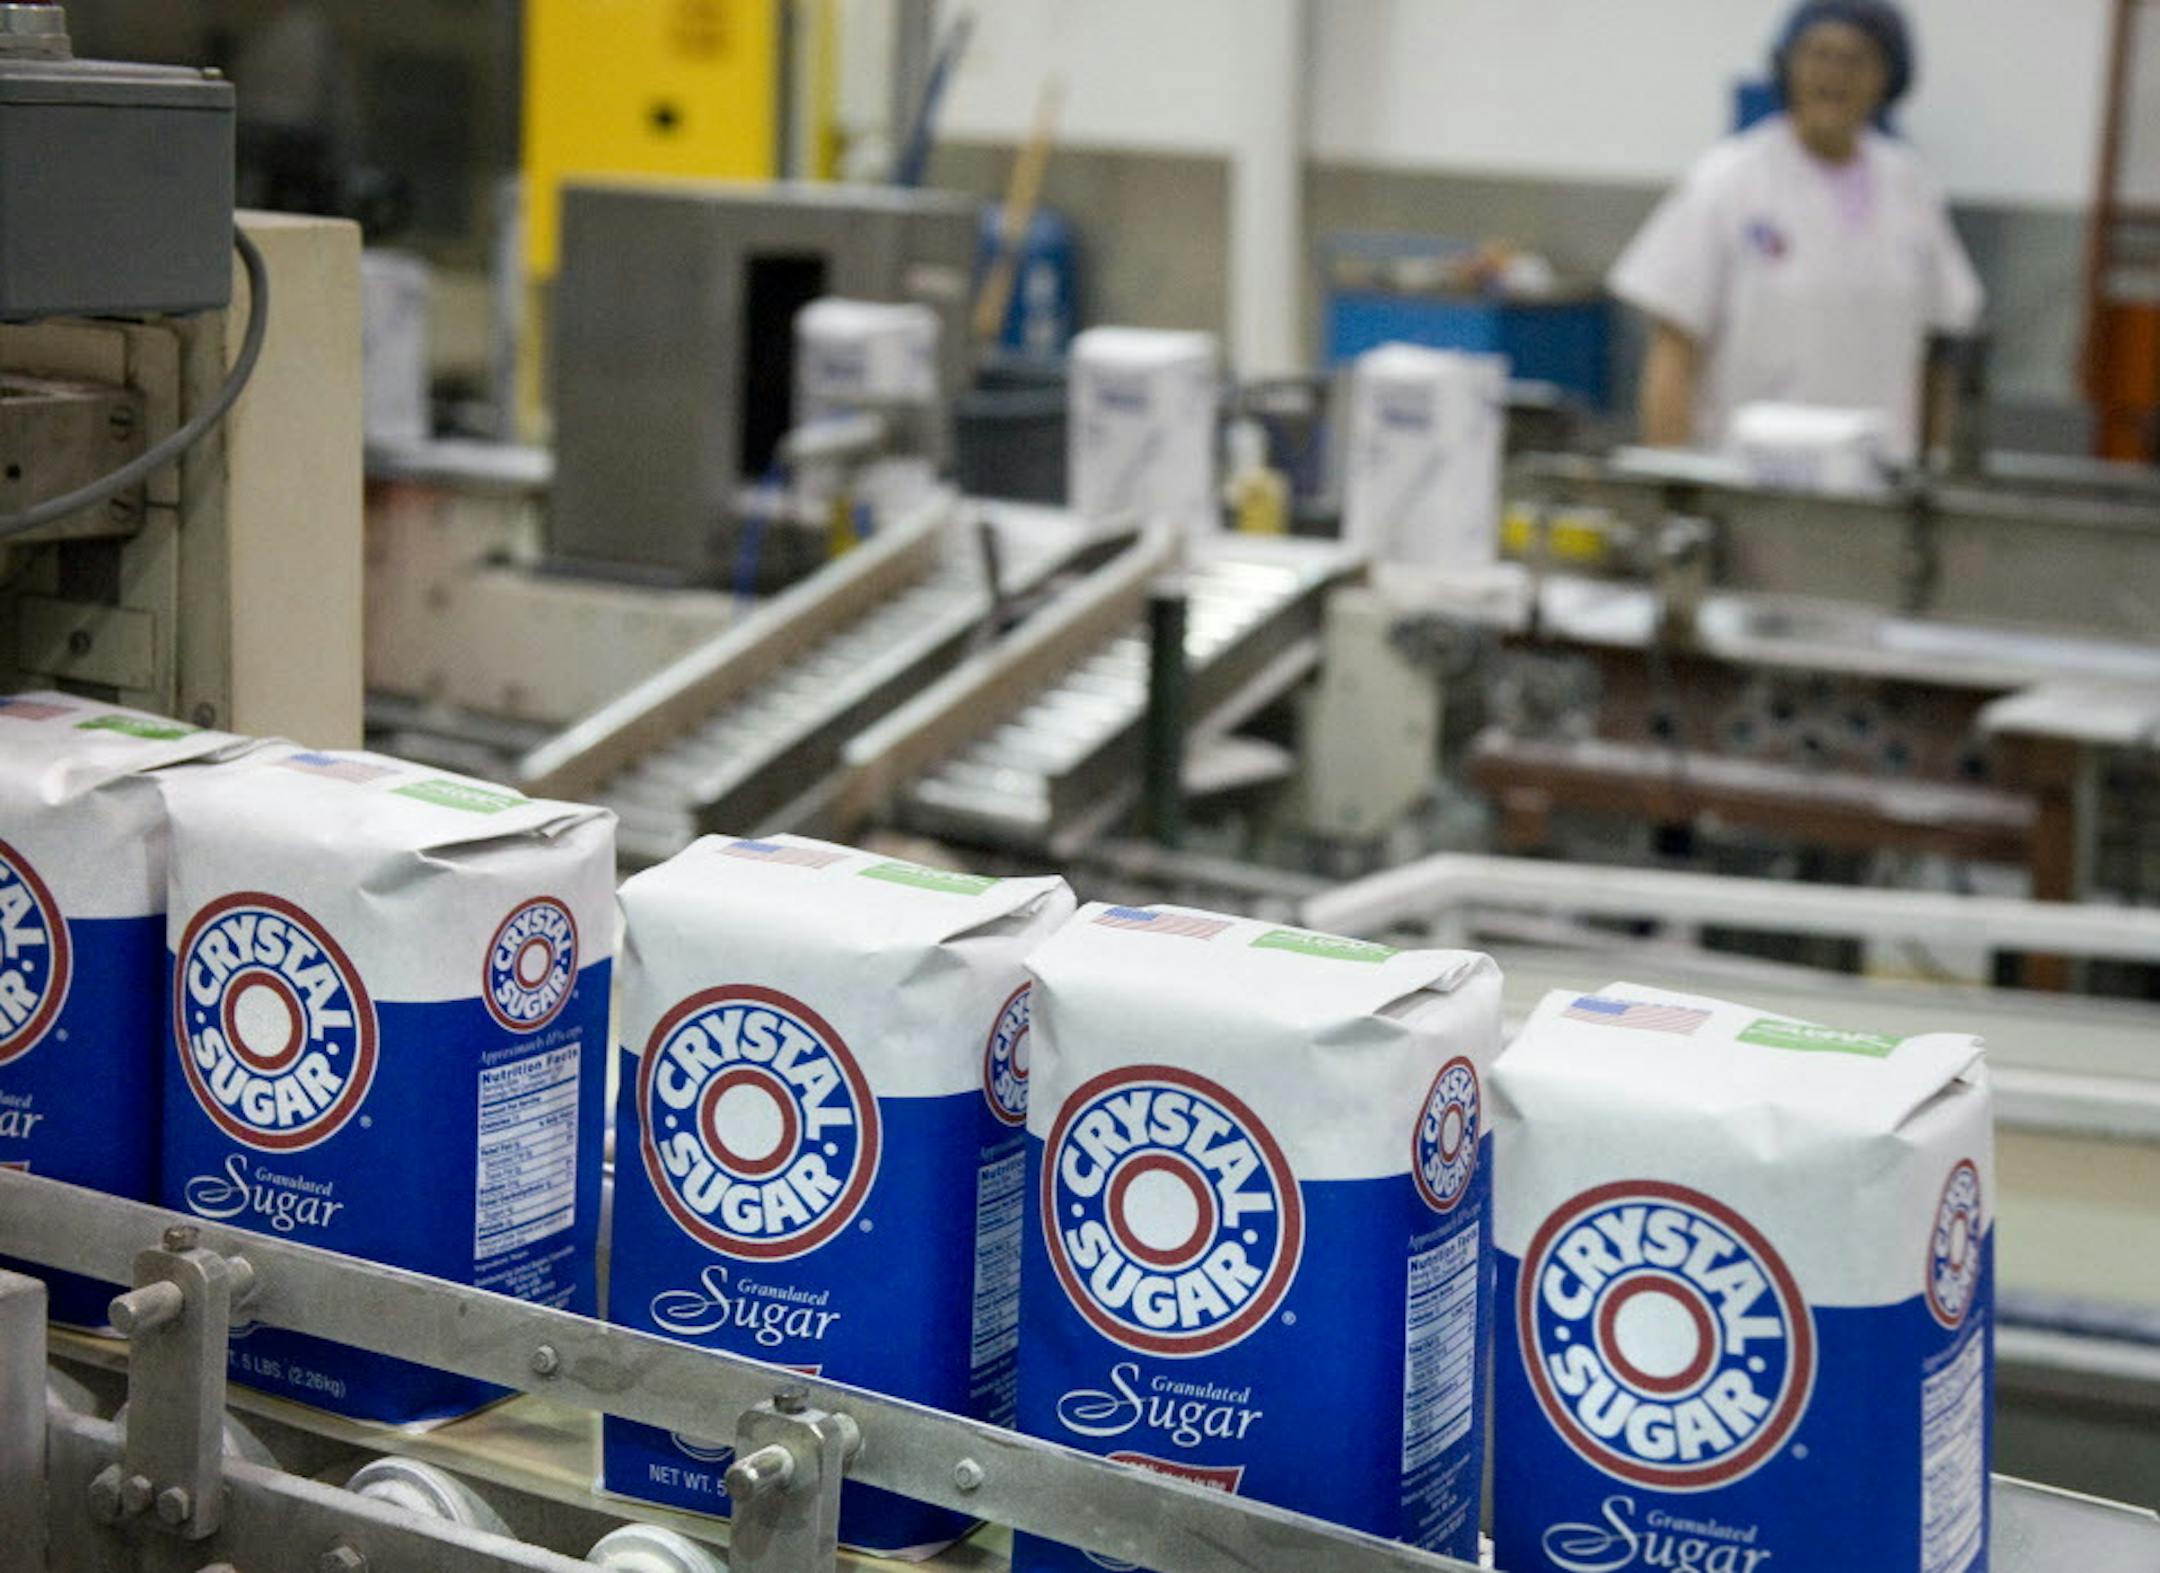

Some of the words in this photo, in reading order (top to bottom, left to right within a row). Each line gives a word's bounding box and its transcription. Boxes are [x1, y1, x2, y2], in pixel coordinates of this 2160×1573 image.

[188, 911, 353, 1040] CRYSTAL
[494, 907, 572, 972] CRYSTAL
[495, 965, 569, 1019] SUGAR
[192, 1027, 344, 1127] SUGAR
[657, 1009, 853, 1140] CRYSTAL
[184, 1153, 344, 1231] Sugar
[254, 1166, 334, 1197] Granulated
[661, 1131, 842, 1234] SUGAR
[1061, 1090, 1274, 1229] CRYSTAL
[650, 1264, 841, 1346] Sugar
[737, 1278, 830, 1306] Granulated
[1066, 1220, 1263, 1330] SUGAR
[1542, 1207, 1783, 1356] CRYSTAL
[1057, 1362, 1263, 1447] Sugar
[1151, 1375, 1252, 1404] Granulated
[1548, 1345, 1770, 1460] SUGAR
[649, 1463, 679, 1487] NET
[683, 1471, 712, 1493] WT.
[1645, 1509, 1759, 1544] Granulated
